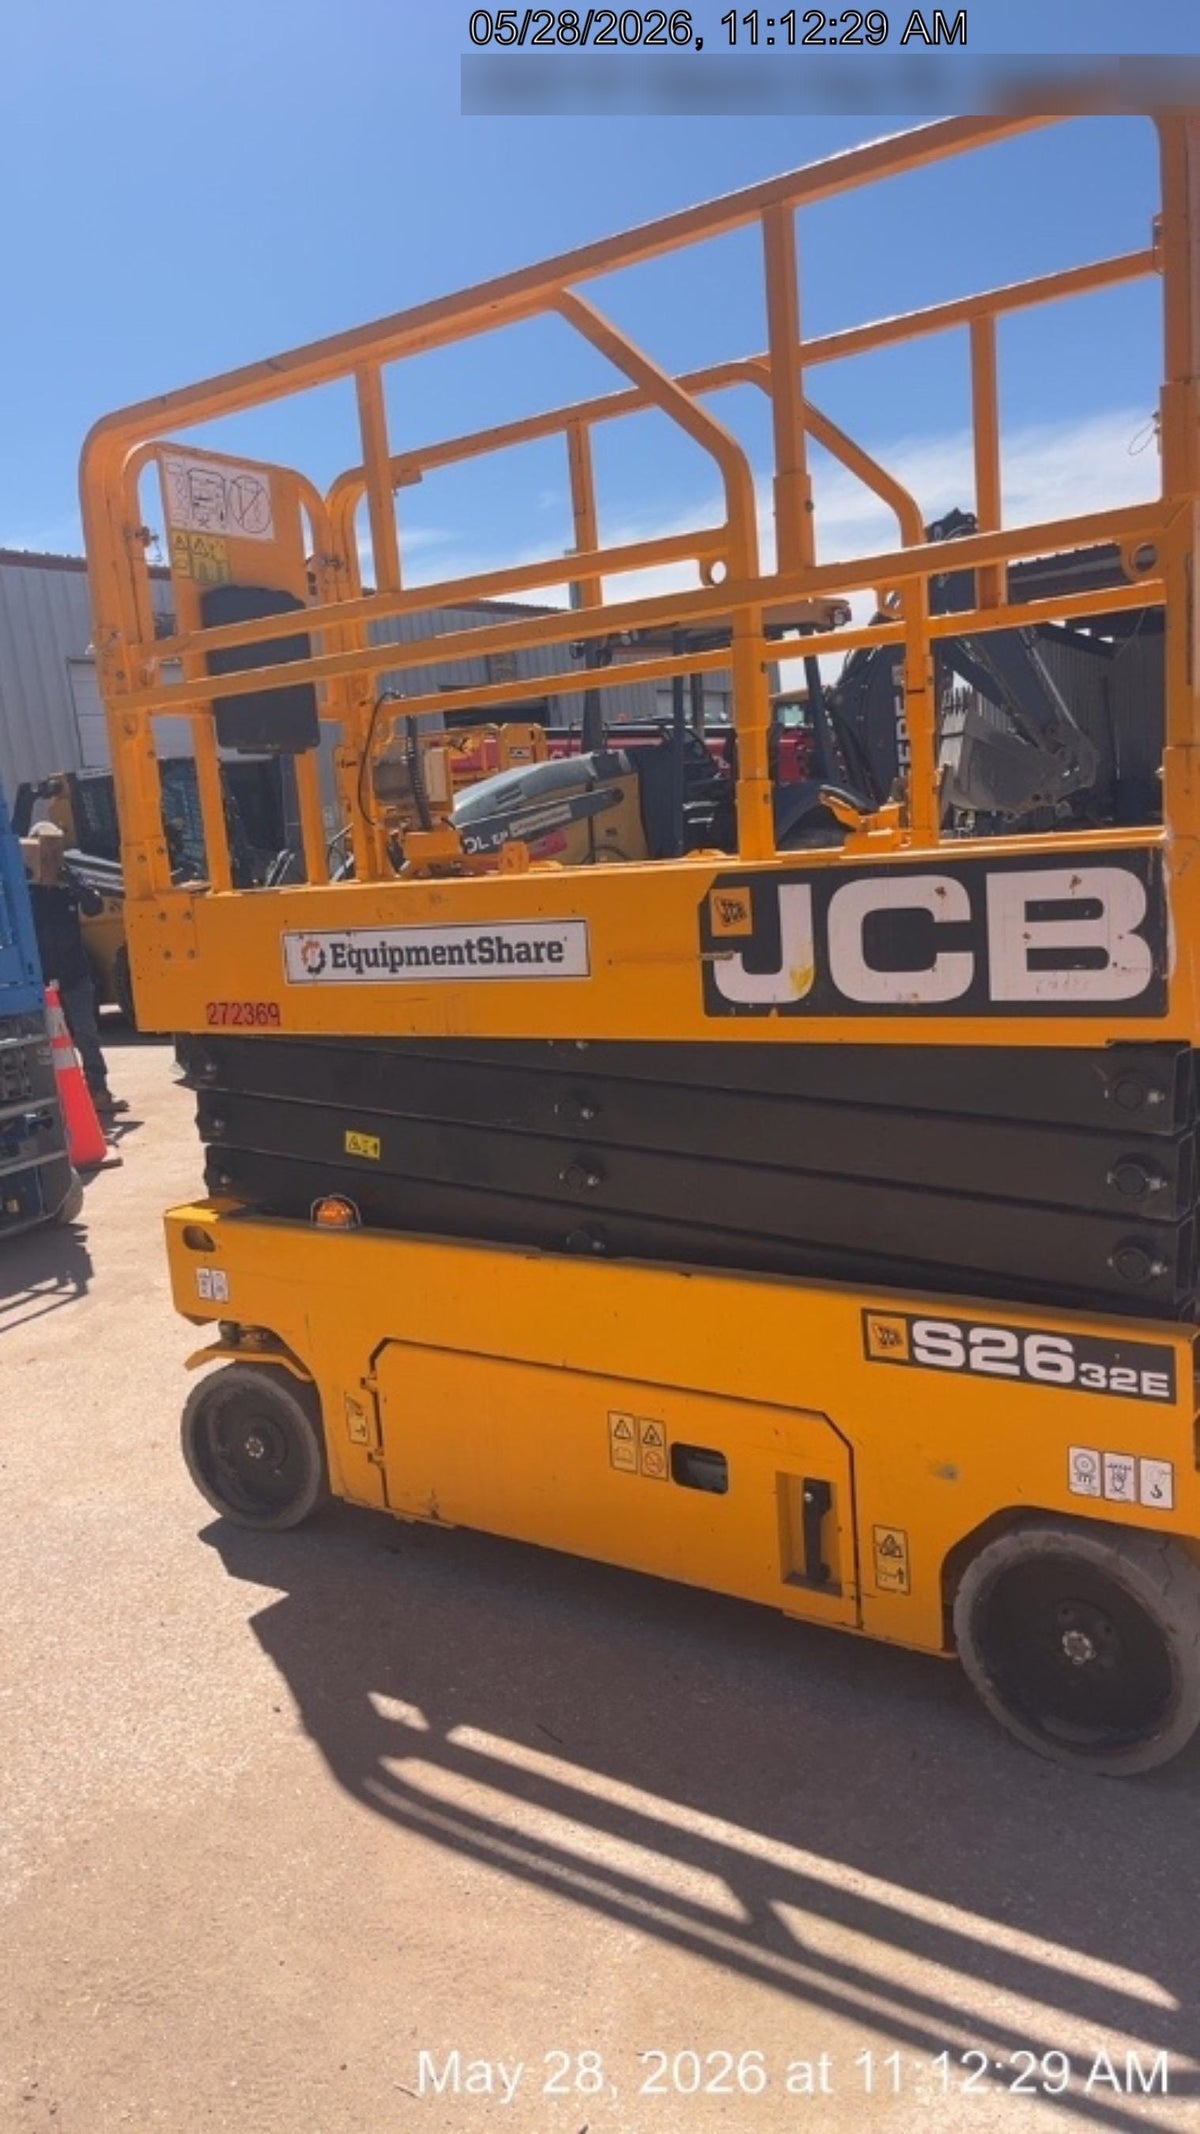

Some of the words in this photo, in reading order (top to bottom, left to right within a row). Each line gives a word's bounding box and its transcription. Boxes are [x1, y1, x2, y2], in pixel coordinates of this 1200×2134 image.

[713, 866, 1153, 1004] JCB
[329, 936, 565, 975] EquipmentShare
[206, 1001, 282, 1027] 272369
